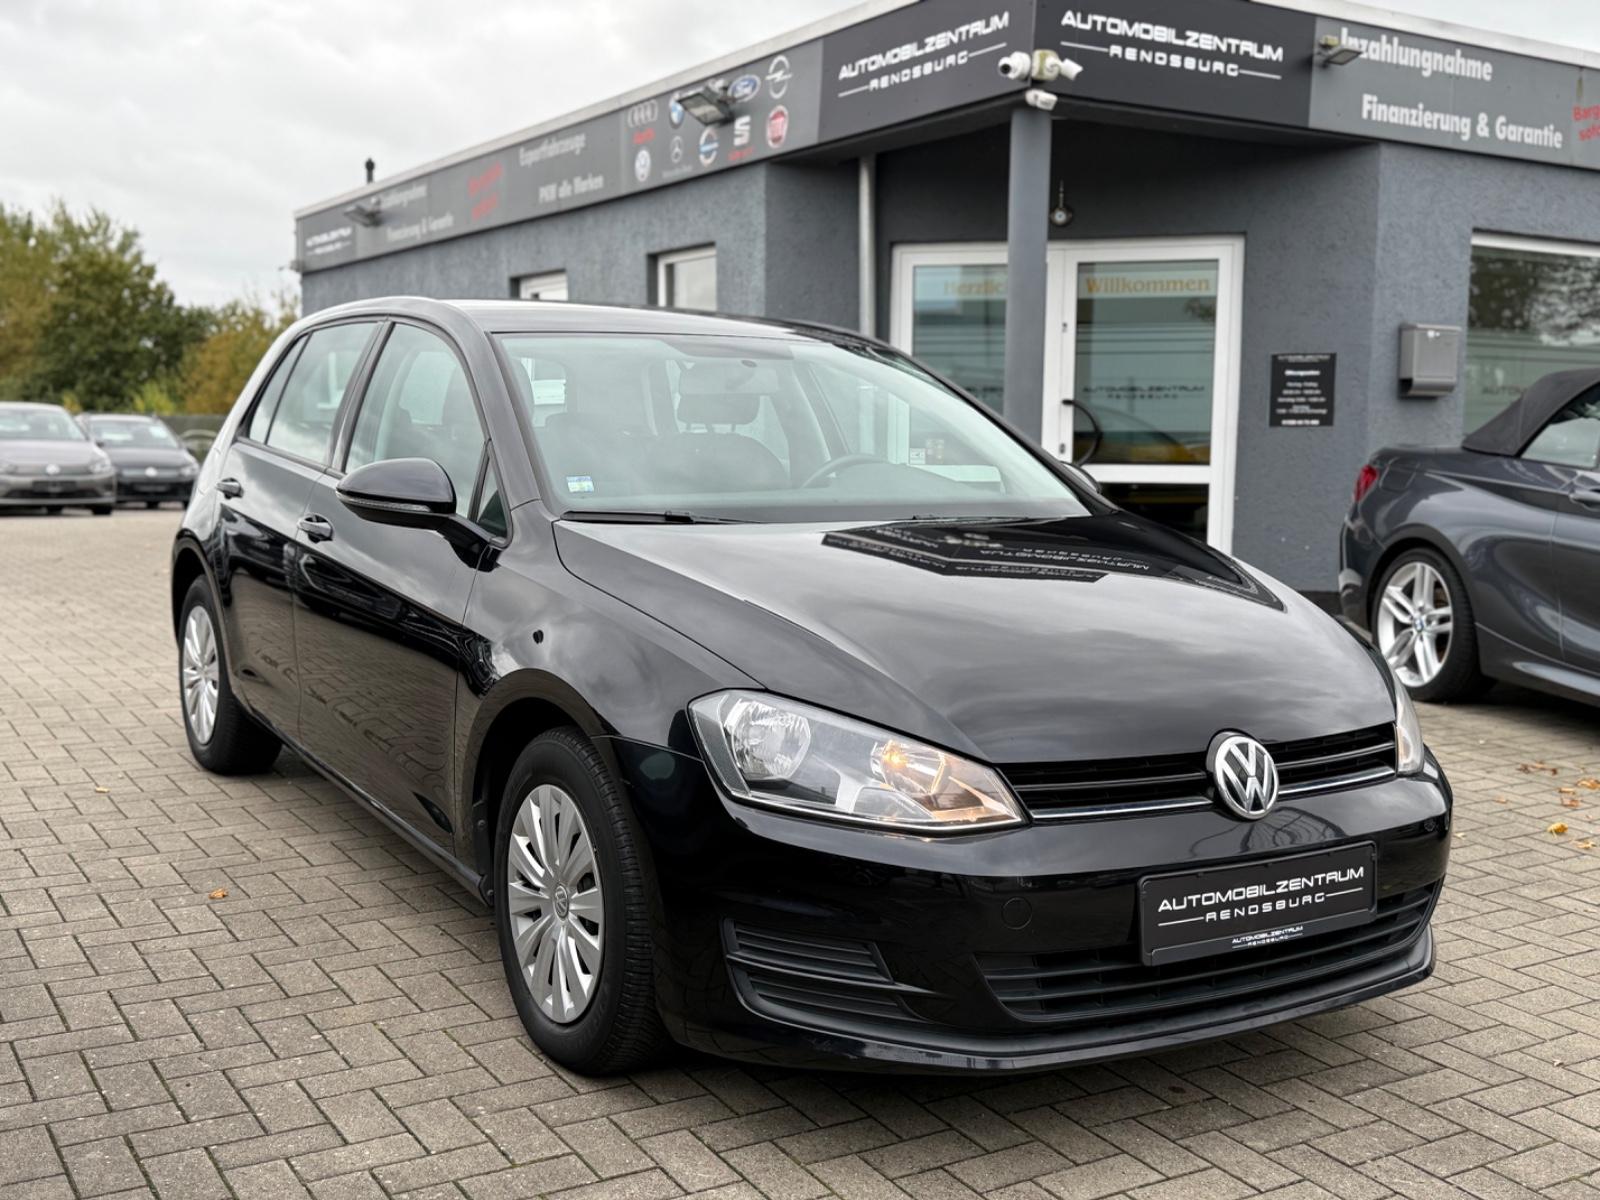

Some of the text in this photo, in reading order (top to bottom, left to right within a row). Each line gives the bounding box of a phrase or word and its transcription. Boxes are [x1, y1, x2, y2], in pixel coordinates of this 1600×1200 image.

[838, 12, 1009, 80] AUTOMOBILZENTRUM
[1061, 9, 1283, 62] AUTOMOBILZENTRUM
[868, 51, 968, 91] RENDSBURG
[1109, 45, 1239, 76] RENDSBURG
[1362, 94, 1563, 149] Finanzierung & Garantie
[1085, 277, 1211, 294] Willkommen
[1158, 866, 1365, 912] AUTOMOBILZENTRUM
[1205, 892, 1325, 922] RENDSBURG
[1232, 925, 1303, 943] AUTOMOBILZENTRUM
